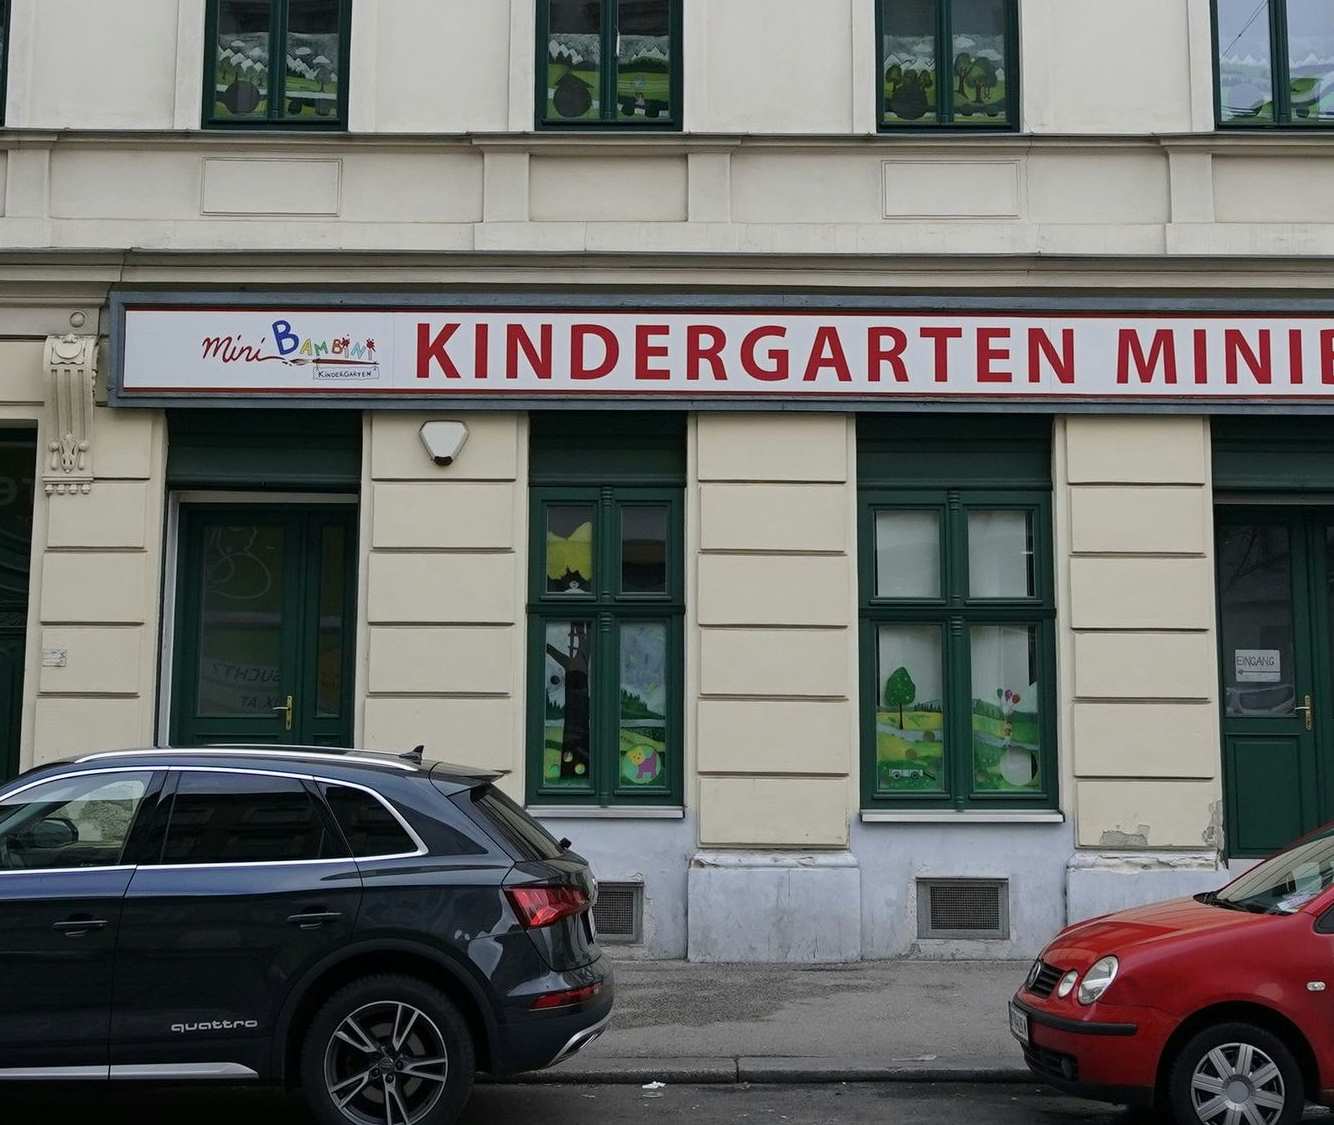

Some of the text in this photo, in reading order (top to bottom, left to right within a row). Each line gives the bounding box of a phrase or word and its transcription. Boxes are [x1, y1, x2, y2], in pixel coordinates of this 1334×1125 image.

[417, 322, 1075, 384] KINDERGARTEN
[1236, 656, 1275, 666] EINGANG
[171, 1019, 258, 1033] quattro
